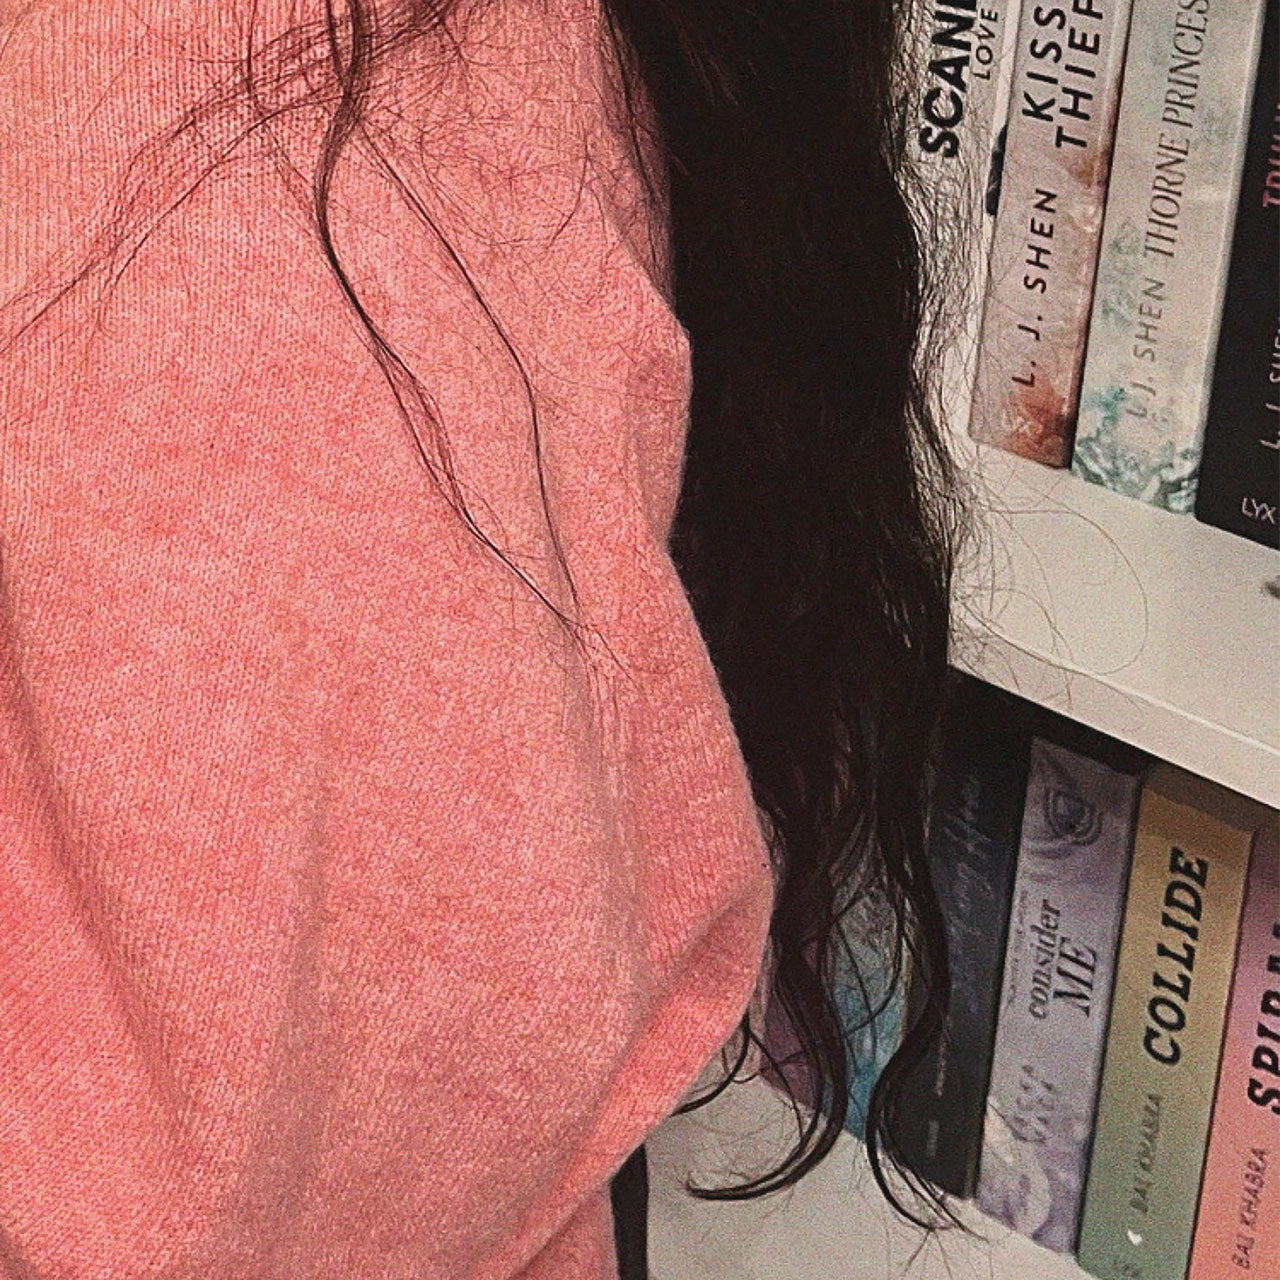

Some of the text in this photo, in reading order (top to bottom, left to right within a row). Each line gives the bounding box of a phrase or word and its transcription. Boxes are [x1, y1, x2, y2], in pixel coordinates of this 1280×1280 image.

[971, 6, 1001, 81] LOVE
[1021, 3, 1069, 124] KISS
[1022, 186, 1059, 295] SHEN
[1143, 132, 1191, 258] THORNE
[1133, 278, 1166, 361] SHEN
[1010, 357, 1037, 388] L.
[1240, 496, 1278, 525] LYX
[1027, 898, 1062, 1020] consider
[1052, 935, 1098, 1018] ME
[1141, 845, 1210, 1067] COLLIDE
[1246, 923, 1280, 1116] SPIR
[1238, 1146, 1267, 1231] KHABRA
